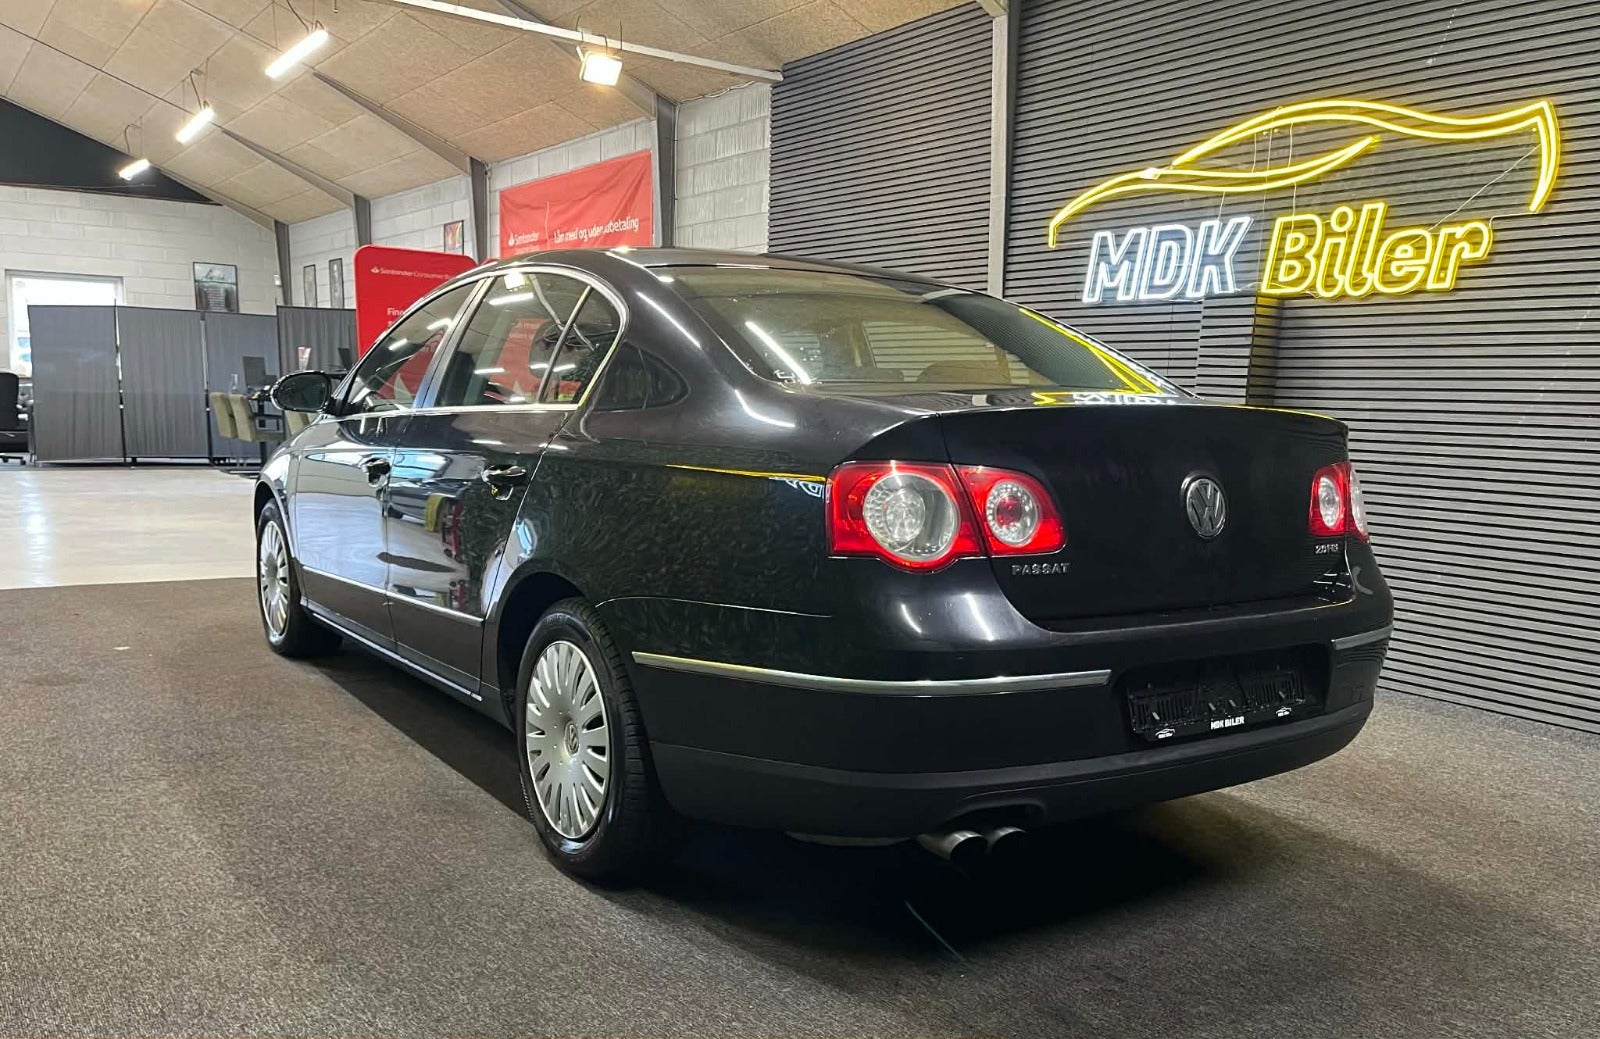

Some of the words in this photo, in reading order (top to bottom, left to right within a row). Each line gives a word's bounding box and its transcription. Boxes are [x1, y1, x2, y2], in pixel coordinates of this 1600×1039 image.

[578, 228, 588, 242] og
[1082, 216, 1254, 303] MDK
[1260, 202, 1493, 298] Biler
[1011, 562, 1070, 576] PASSAT
[1224, 716, 1245, 727] BILER
